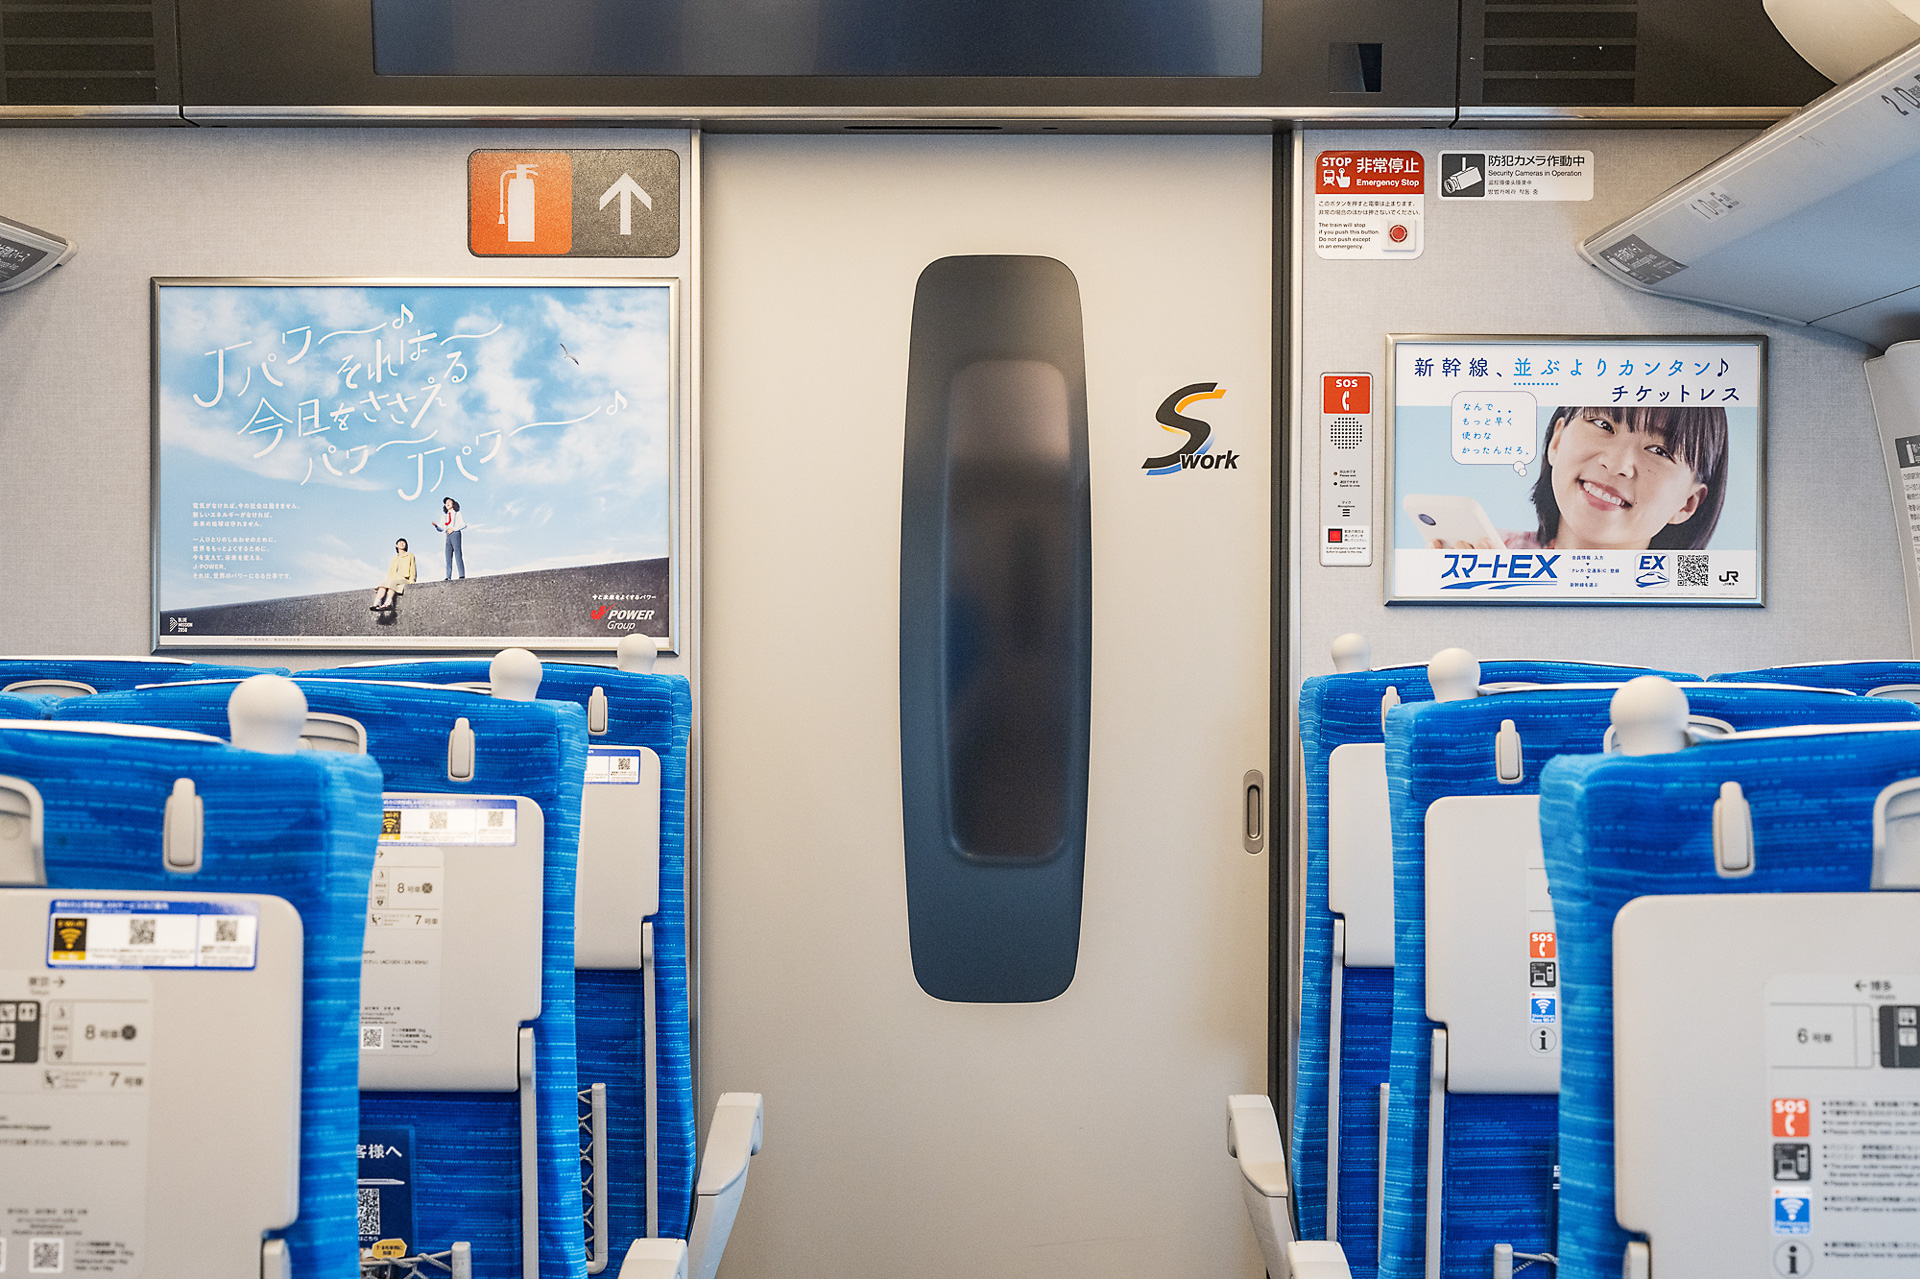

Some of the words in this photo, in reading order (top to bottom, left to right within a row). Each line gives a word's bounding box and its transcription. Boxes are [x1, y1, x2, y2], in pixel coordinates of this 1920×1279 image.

[1321, 156, 1352, 167] STOP
[1356, 156, 1420, 173] 非常停止
[1487, 154, 1586, 167] 防犯カメラ作動中
[1488, 169, 1514, 178] Security
[1515, 169, 1543, 178] Cameras
[1544, 169, 1551, 177] in
[1551, 169, 1582, 178] Operation
[1356, 178, 1400, 187] Emergency
[1401, 178, 1420, 187] Stop
[1335, 378, 1358, 388] SOS
[1610, 383, 1741, 403] チケットレス
[1461, 416, 1514, 427] もっと早く
[1461, 431, 1492, 441] 使わな
[1180, 449, 1241, 470] work
[1440, 554, 1562, 579] スマートEX
[1639, 555, 1667, 570] EX
[1718, 570, 1739, 582] JR
[607, 609, 656, 620] POWER
[607, 620, 636, 632] Group
[1531, 933, 1554, 942] SOS
[1774, 1100, 1807, 1114] SOS
